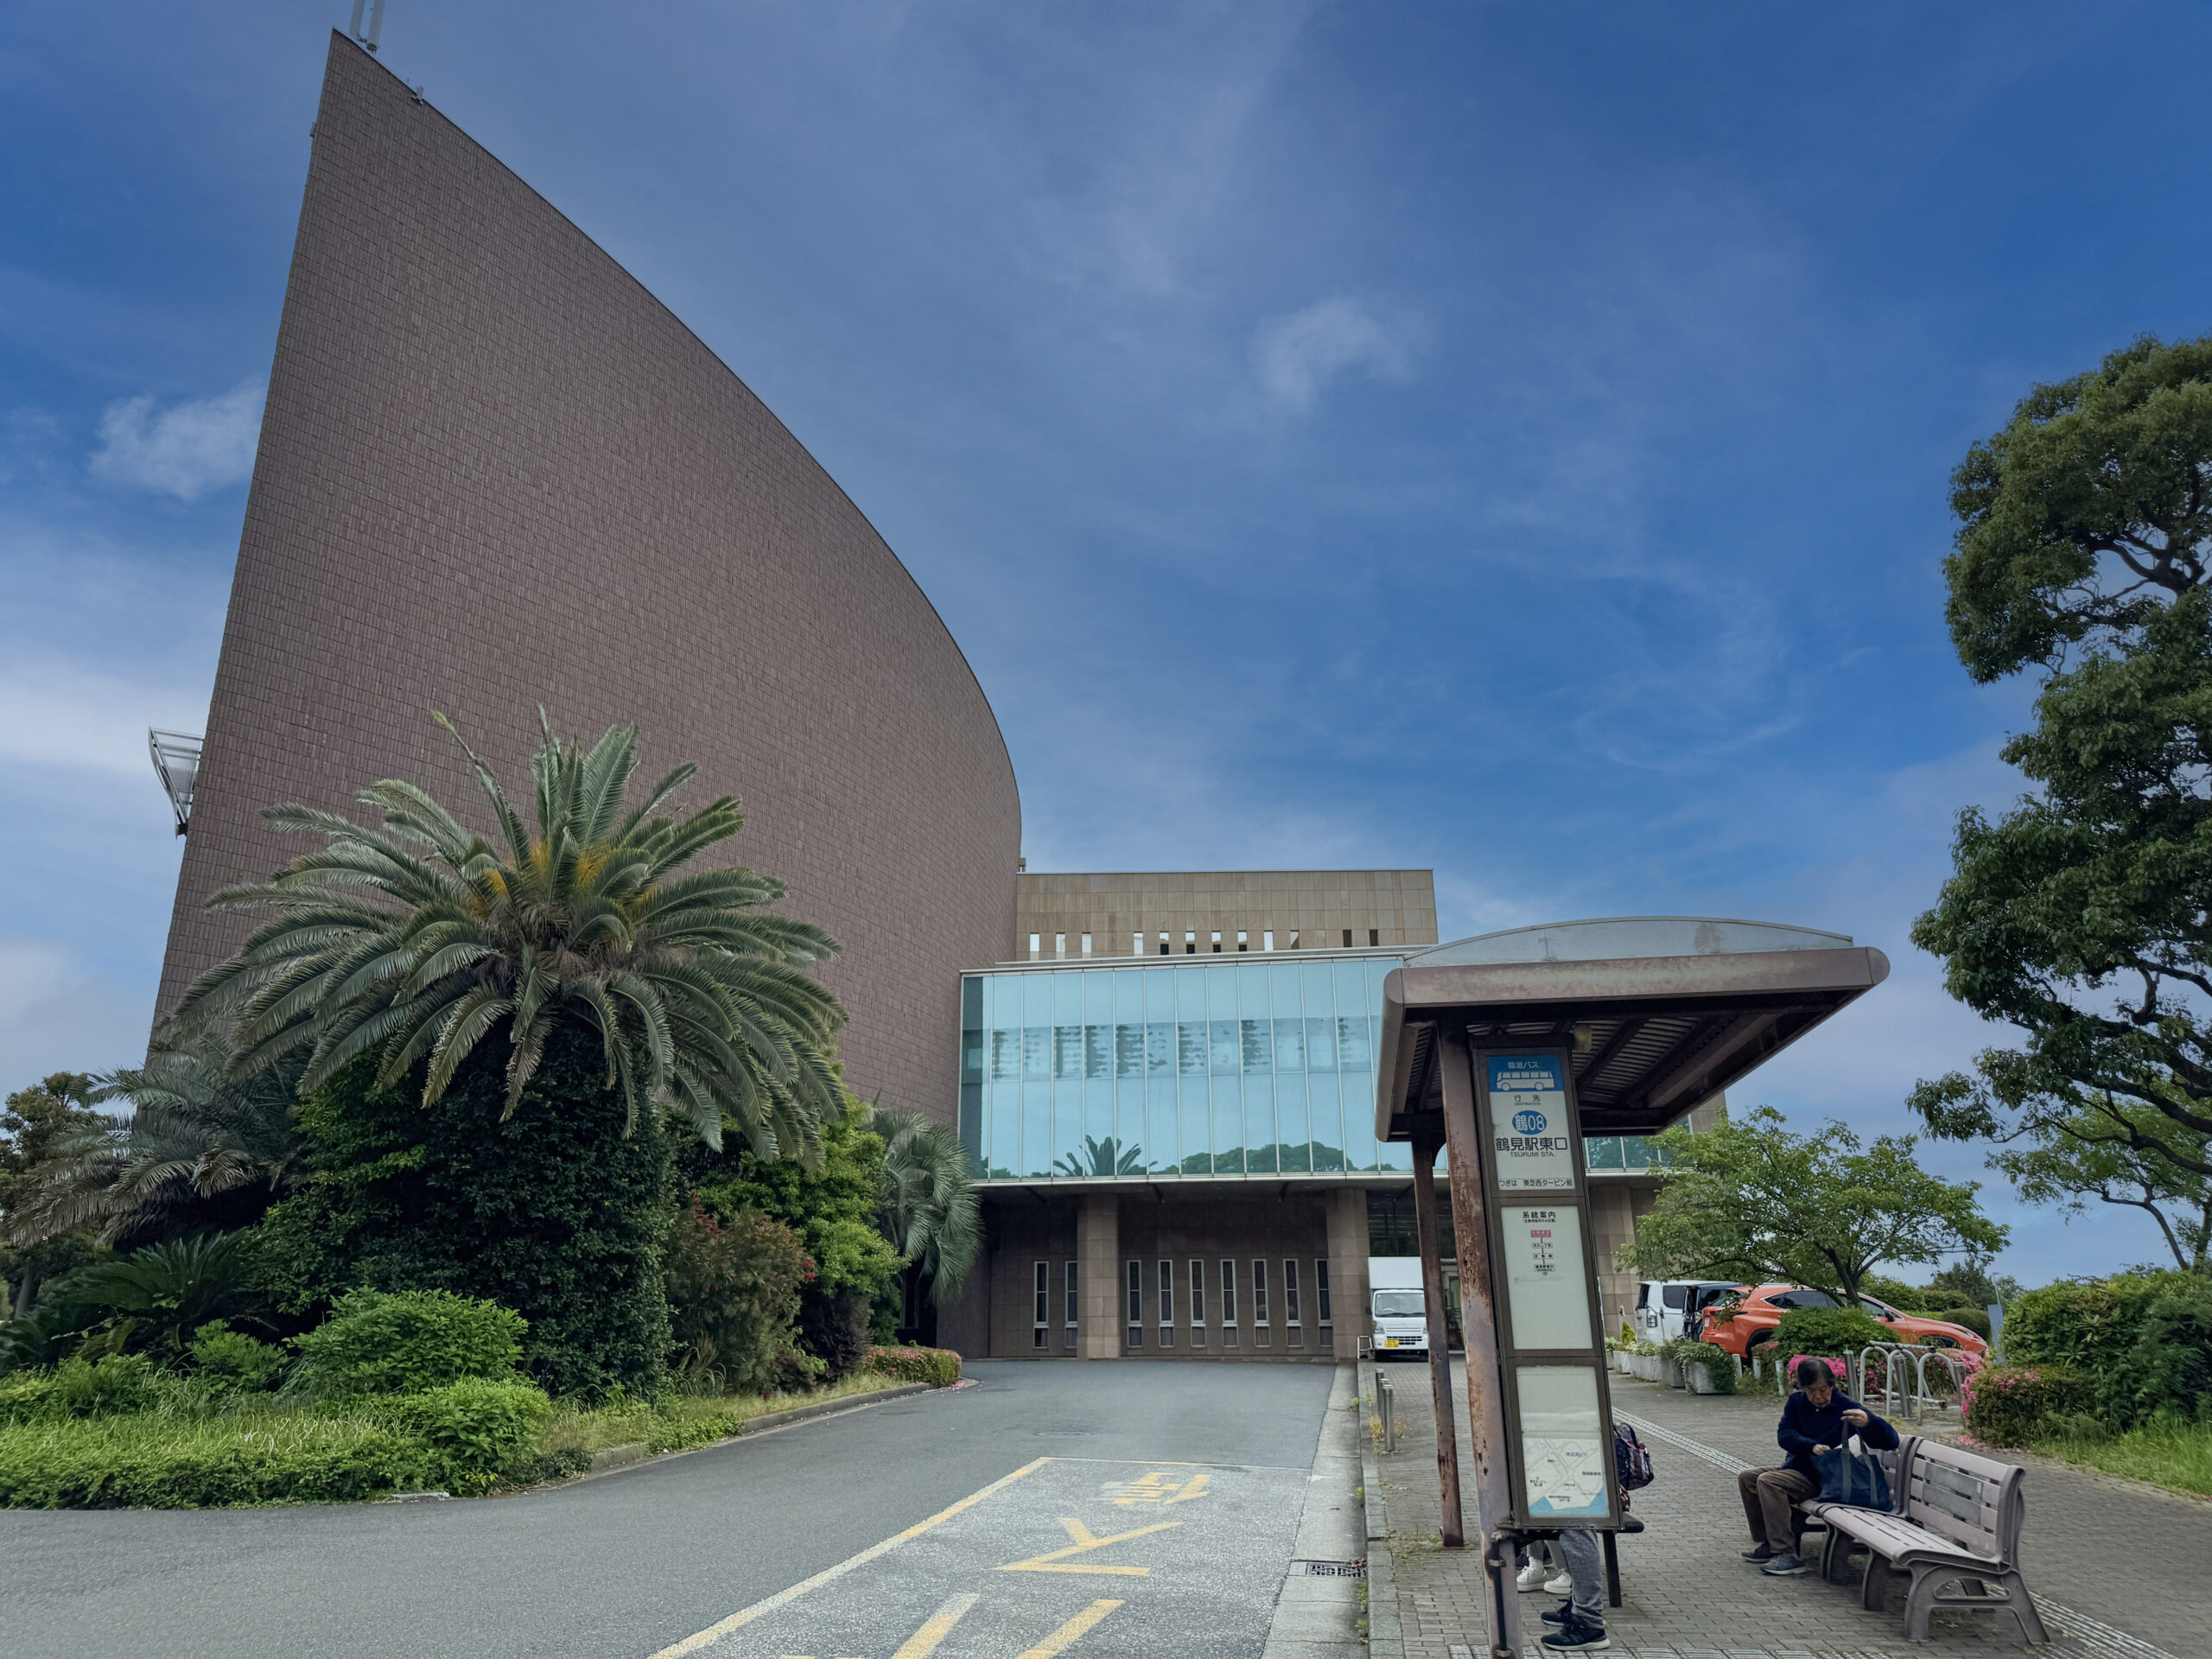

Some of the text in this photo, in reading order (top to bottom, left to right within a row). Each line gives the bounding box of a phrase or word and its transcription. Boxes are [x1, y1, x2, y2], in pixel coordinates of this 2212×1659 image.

[1515, 1115, 1545, 1131] 鶴08
[1496, 1137, 1568, 1152] 鶴見駅東口
[1522, 1211, 1556, 1219] 系統案内
